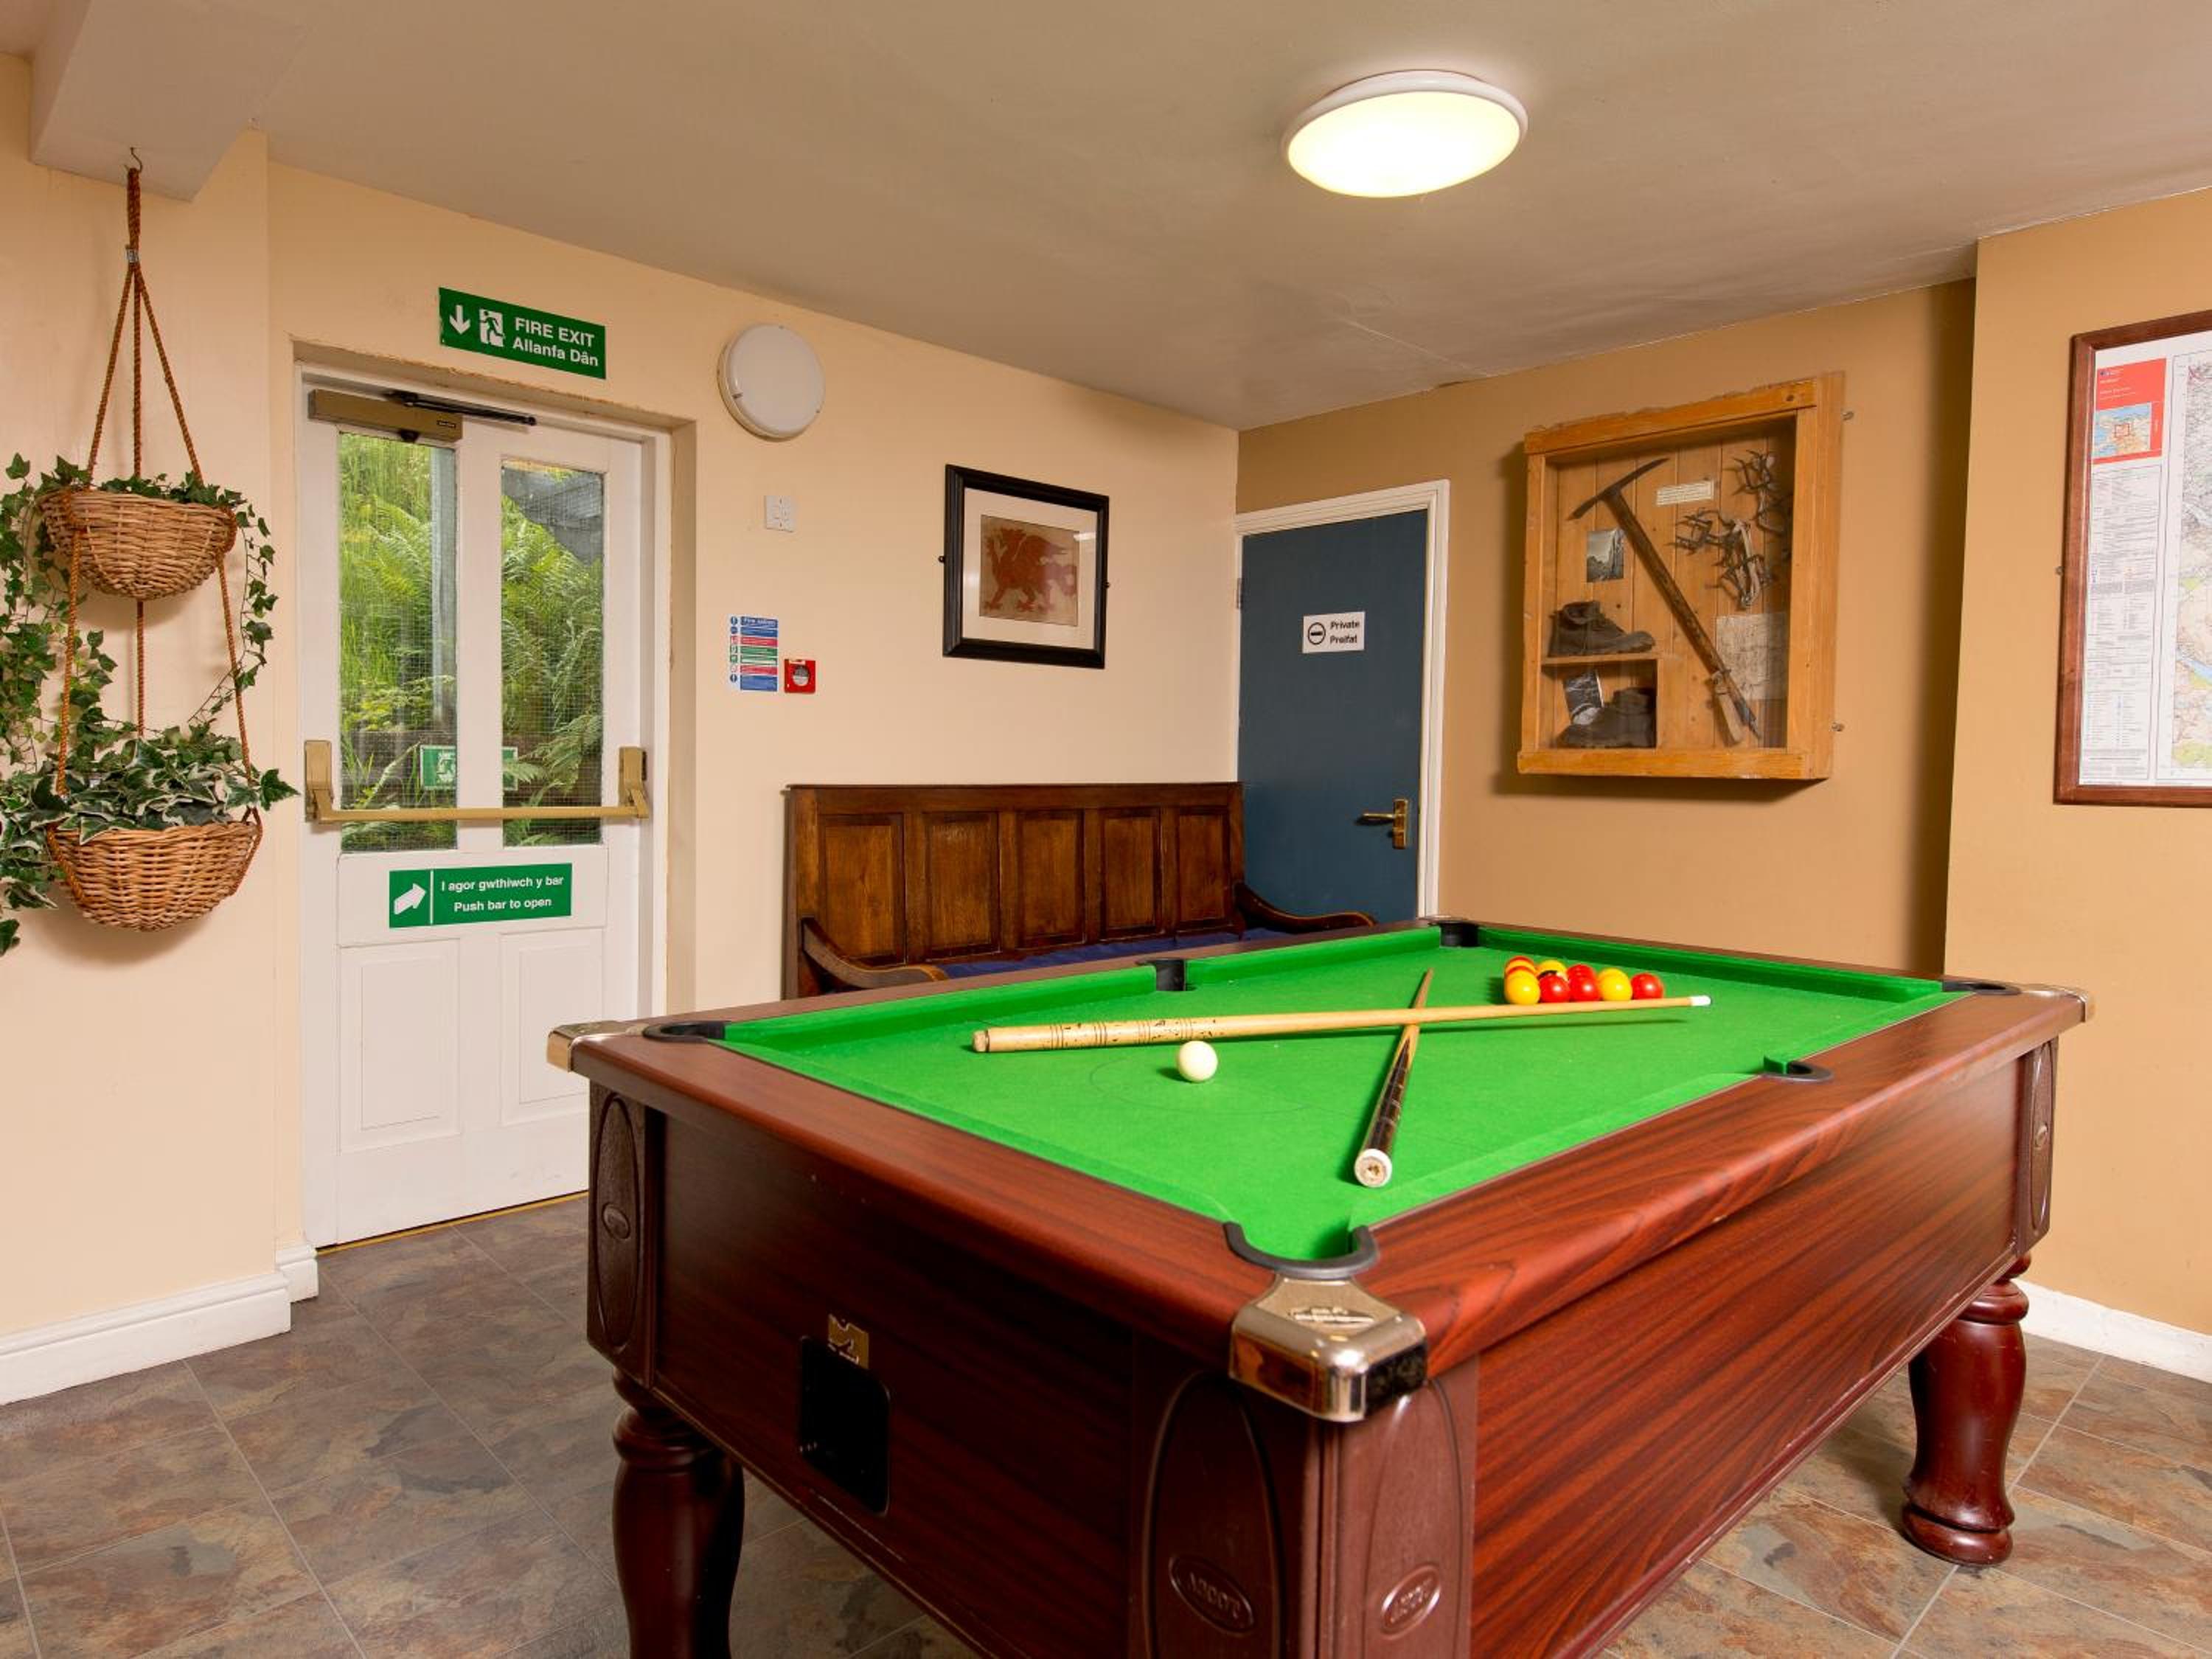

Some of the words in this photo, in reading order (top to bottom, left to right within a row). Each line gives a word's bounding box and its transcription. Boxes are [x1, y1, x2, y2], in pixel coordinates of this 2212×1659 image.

[515, 317, 554, 338] FIRE
[558, 327, 595, 347] EXIT
[512, 337, 566, 360] Allanfa
[570, 349, 599, 366] Dân
[1330, 620, 1360, 630] Private
[441, 881, 446, 891] I
[448, 882, 476, 893] agor
[479, 877, 533, 891] gwthiwch
[535, 879, 543, 889] y
[545, 876, 564, 886] bar
[454, 900, 484, 912] Push
[487, 899, 507, 910] bar
[509, 898, 521, 909] to
[524, 898, 552, 909] open
